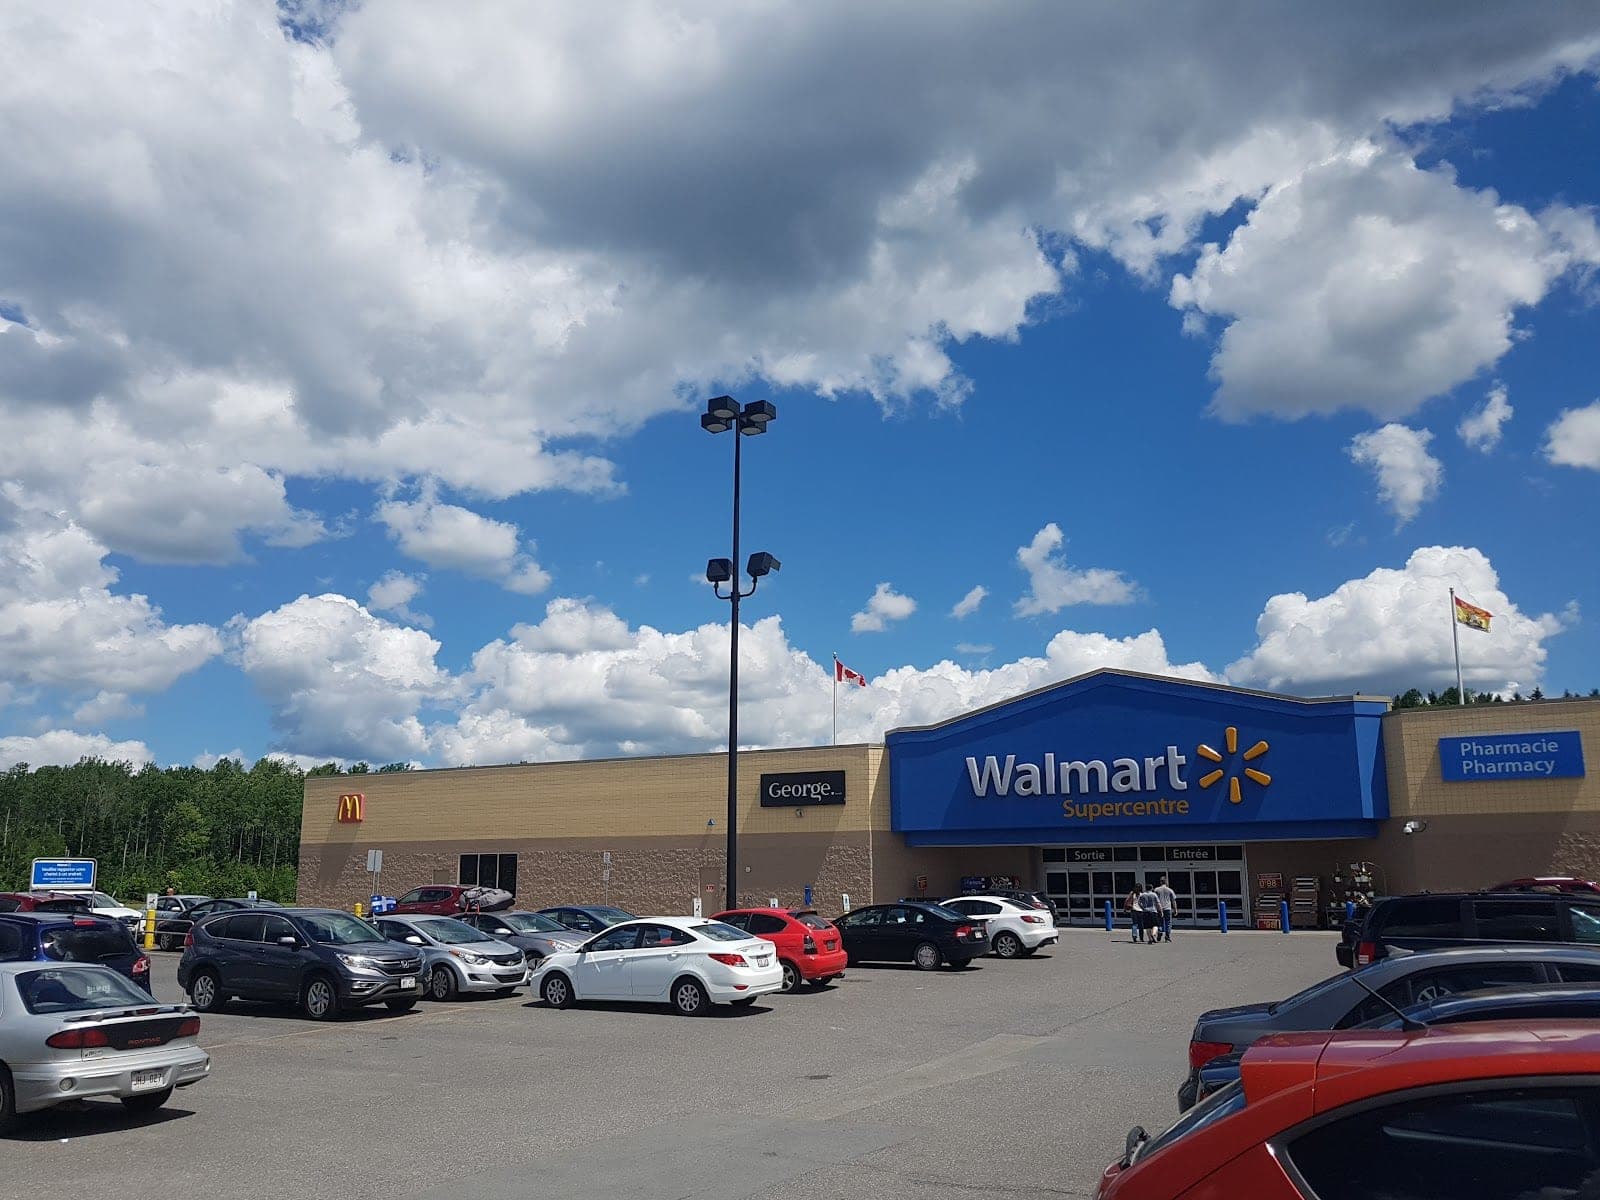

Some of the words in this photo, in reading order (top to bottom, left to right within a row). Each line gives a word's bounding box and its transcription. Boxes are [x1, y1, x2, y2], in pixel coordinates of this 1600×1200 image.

[1460, 739, 1559, 756] Pharmacie
[966, 745, 1188, 797] Walmart
[1462, 759, 1555, 775] Pharmacy
[1062, 798, 1189, 822] Supercentre
[1074, 850, 1105, 860] Sortie
[1172, 849, 1208, 859] Entrée
